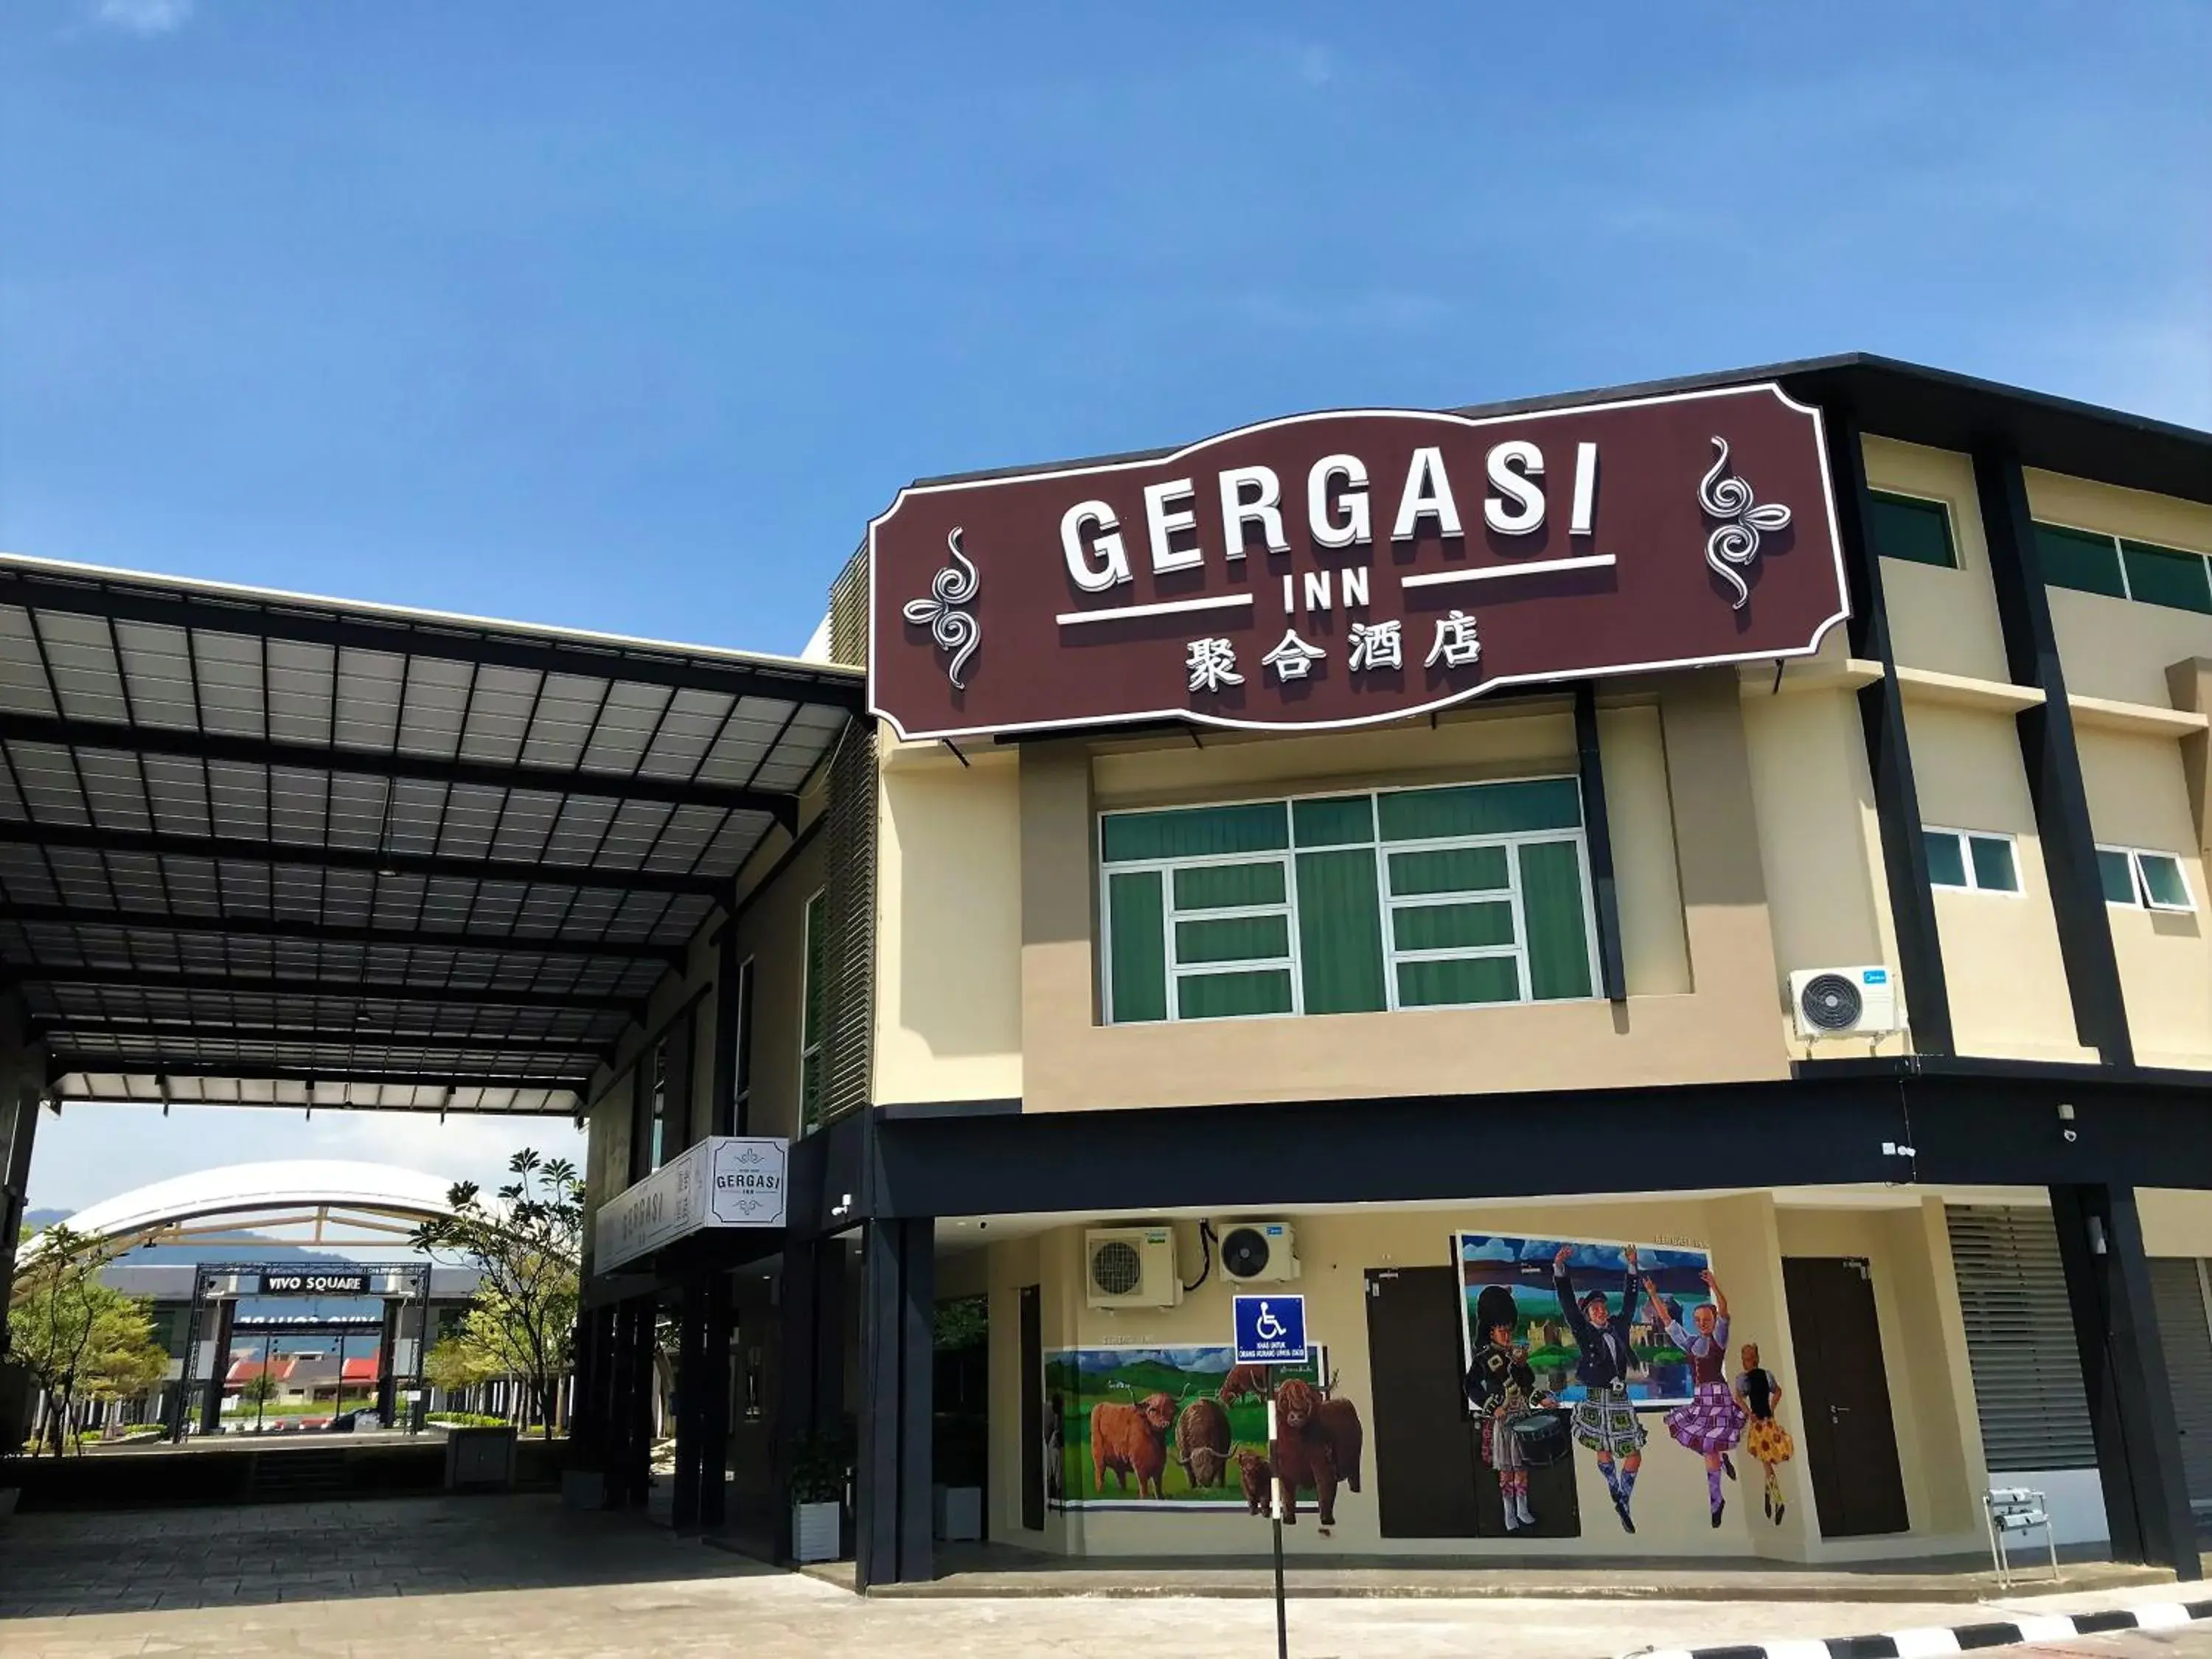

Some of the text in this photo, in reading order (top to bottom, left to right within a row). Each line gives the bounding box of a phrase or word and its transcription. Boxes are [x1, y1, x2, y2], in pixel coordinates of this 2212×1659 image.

[1060, 439, 1599, 594] GERGASI
[1281, 566, 1371, 616] INN
[1186, 609, 1484, 694] 聚合酒店
[716, 1175, 780, 1189] GERGASI
[268, 1276, 362, 1291] VIVO SQUARE
